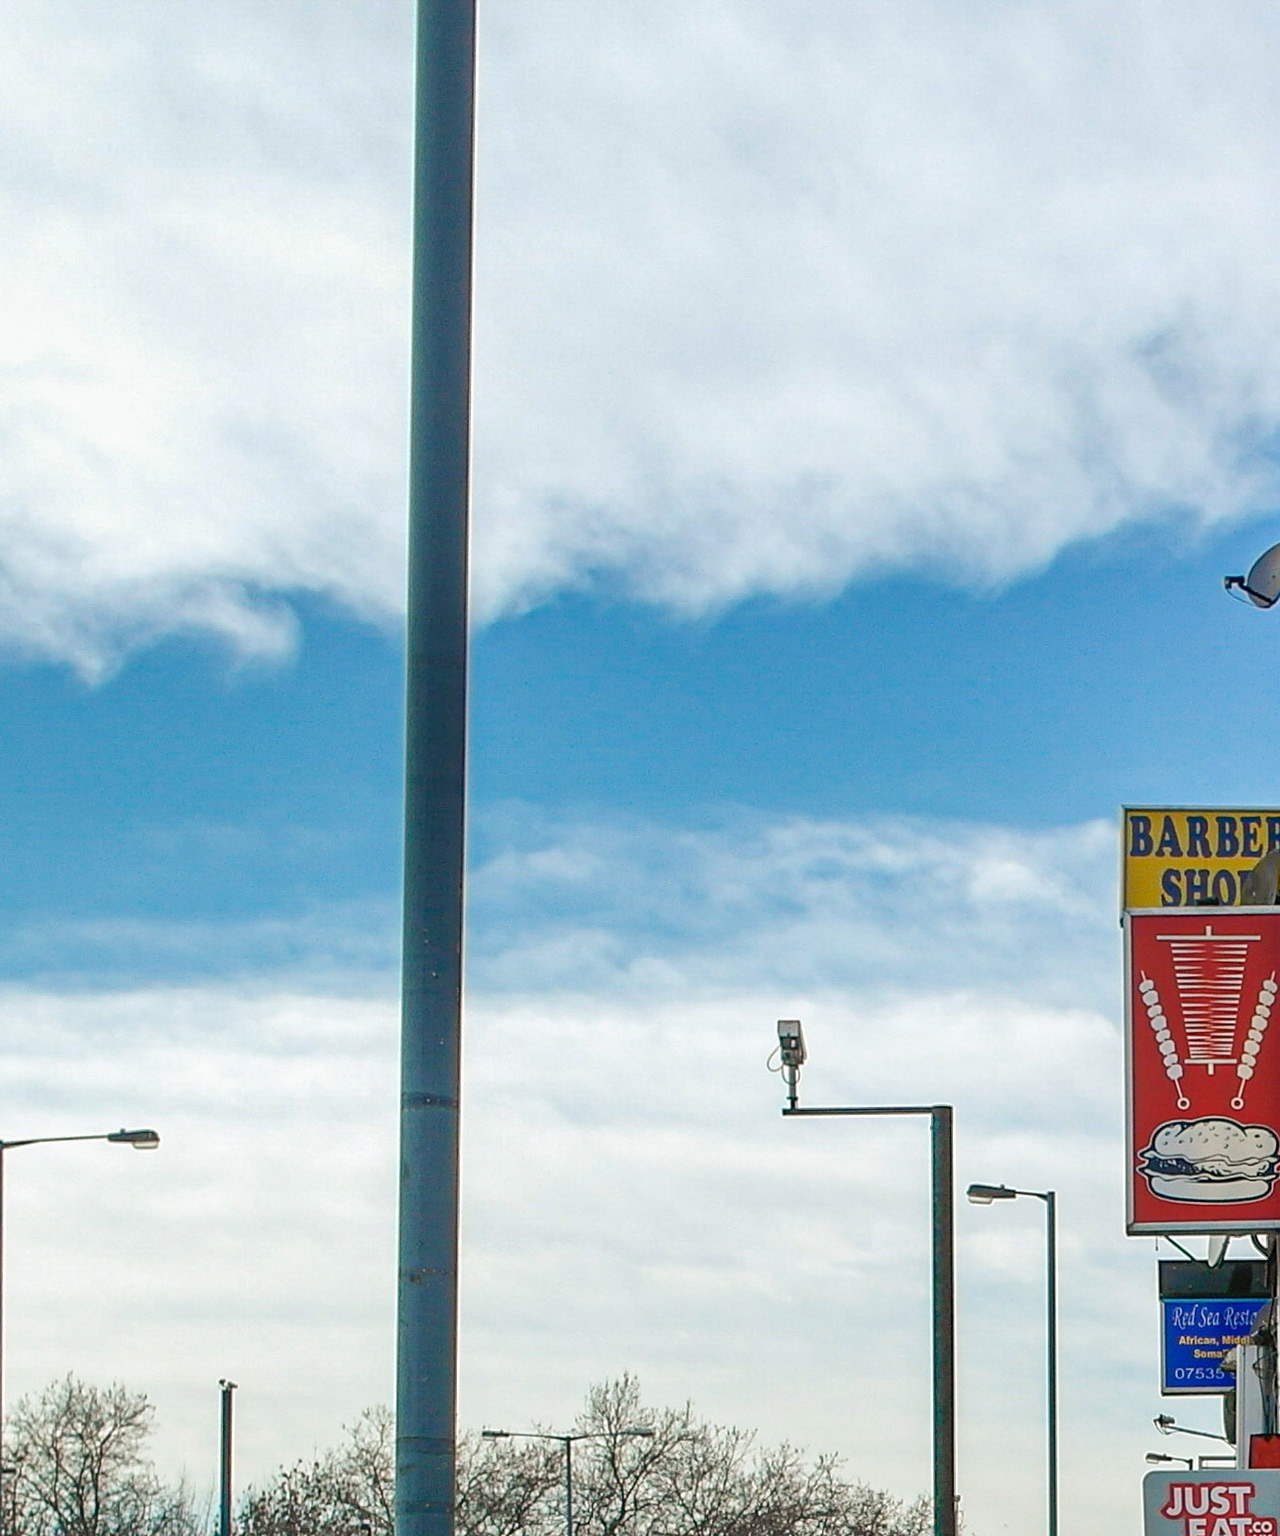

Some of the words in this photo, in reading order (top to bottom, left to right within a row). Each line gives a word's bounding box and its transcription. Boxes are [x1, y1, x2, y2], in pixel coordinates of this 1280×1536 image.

[1161, 868, 1254, 906] SHO
[1173, 1304, 1198, 1330] Red
[1198, 1306, 1220, 1328] Sea
[1179, 1336, 1220, 1346] African,
[1175, 1367, 1225, 1380] 07535
[1166, 1486, 1251, 1516] JUST
